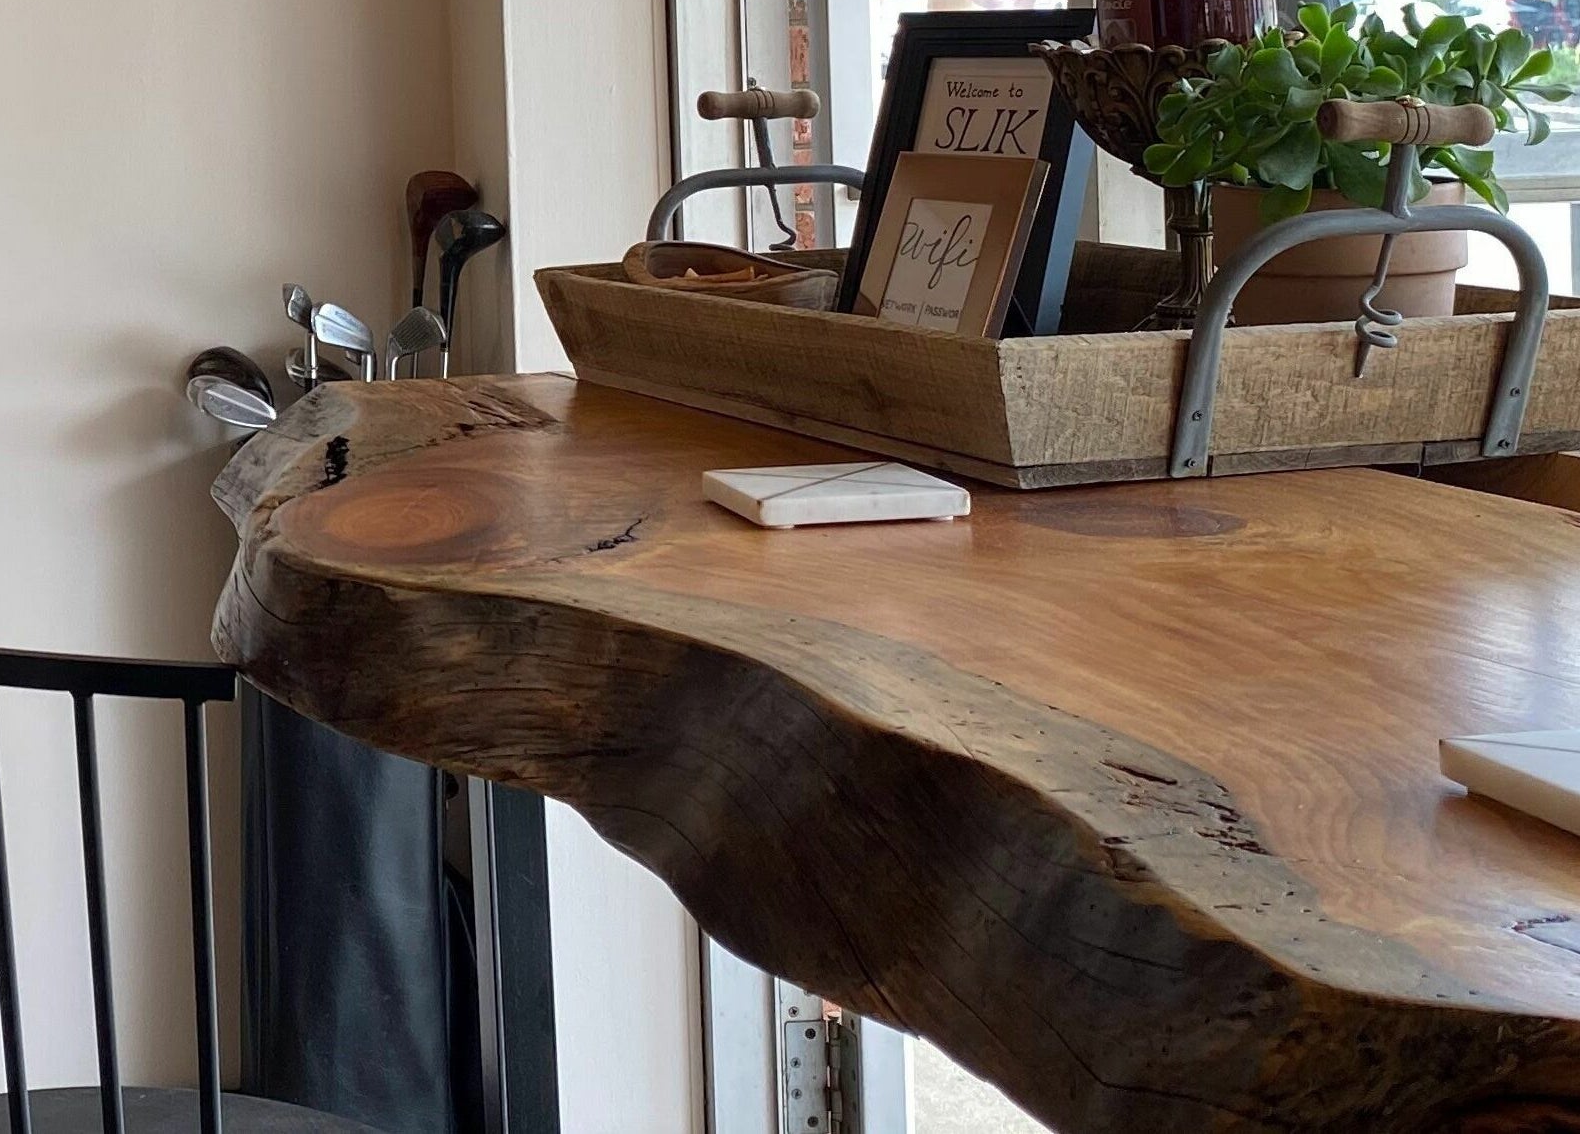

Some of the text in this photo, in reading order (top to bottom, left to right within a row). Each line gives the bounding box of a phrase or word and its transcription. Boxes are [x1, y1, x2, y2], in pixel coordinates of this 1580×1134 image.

[946, 80, 1024, 99] Welcome to
[934, 106, 1040, 155] SLIK
